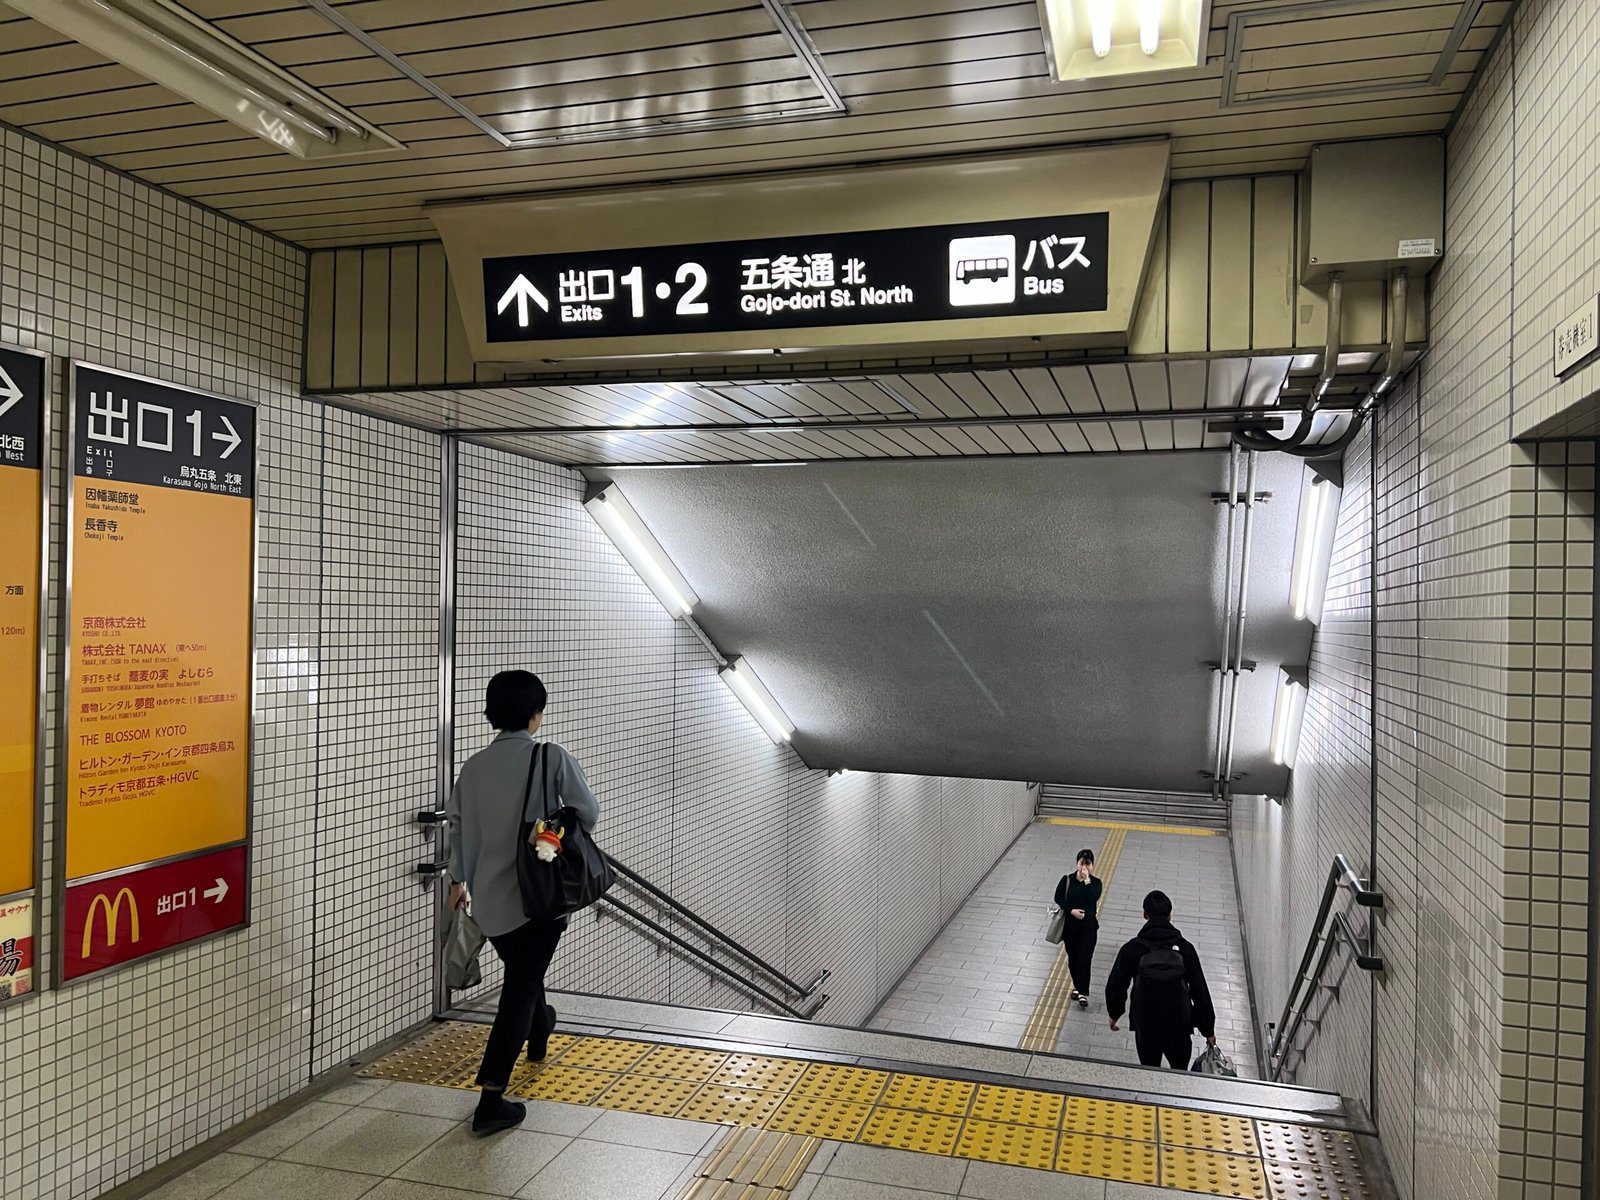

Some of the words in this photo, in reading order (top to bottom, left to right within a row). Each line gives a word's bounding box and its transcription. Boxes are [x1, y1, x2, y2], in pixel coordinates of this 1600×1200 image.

[559, 269, 614, 302] 出口
[740, 253, 835, 290] 五条通
[841, 258, 866, 285] 北
[1022, 234, 1091, 271] バス
[561, 305, 603, 322] Exits
[741, 290, 825, 315] Gojo-dori
[830, 288, 855, 307] St.
[861, 284, 913, 306] North
[1024, 276, 1064, 295] Bus
[86, 446, 113, 457] Exit
[180, 465, 217, 482] 烏丸五条
[225, 472, 242, 485] 北東
[163, 475, 191, 487] Karasuma
[194, 478, 207, 491] Gojo
[210, 482, 226, 492] North
[229, 485, 241, 494] East
[84, 518, 117, 532] 長香寺
[5, 585, 24, 595] 方面
[82, 616, 146, 629] 京商株式会社
[82, 644, 126, 657] 株式会社
[129, 643, 166, 654] TANAX
[82, 672, 121, 684] 手打ちそば
[178, 667, 214, 679] よしむら
[80, 734, 99, 746] THE
[105, 728, 150, 744] BLOSSOM
[155, 724, 187, 738] KYOTO
